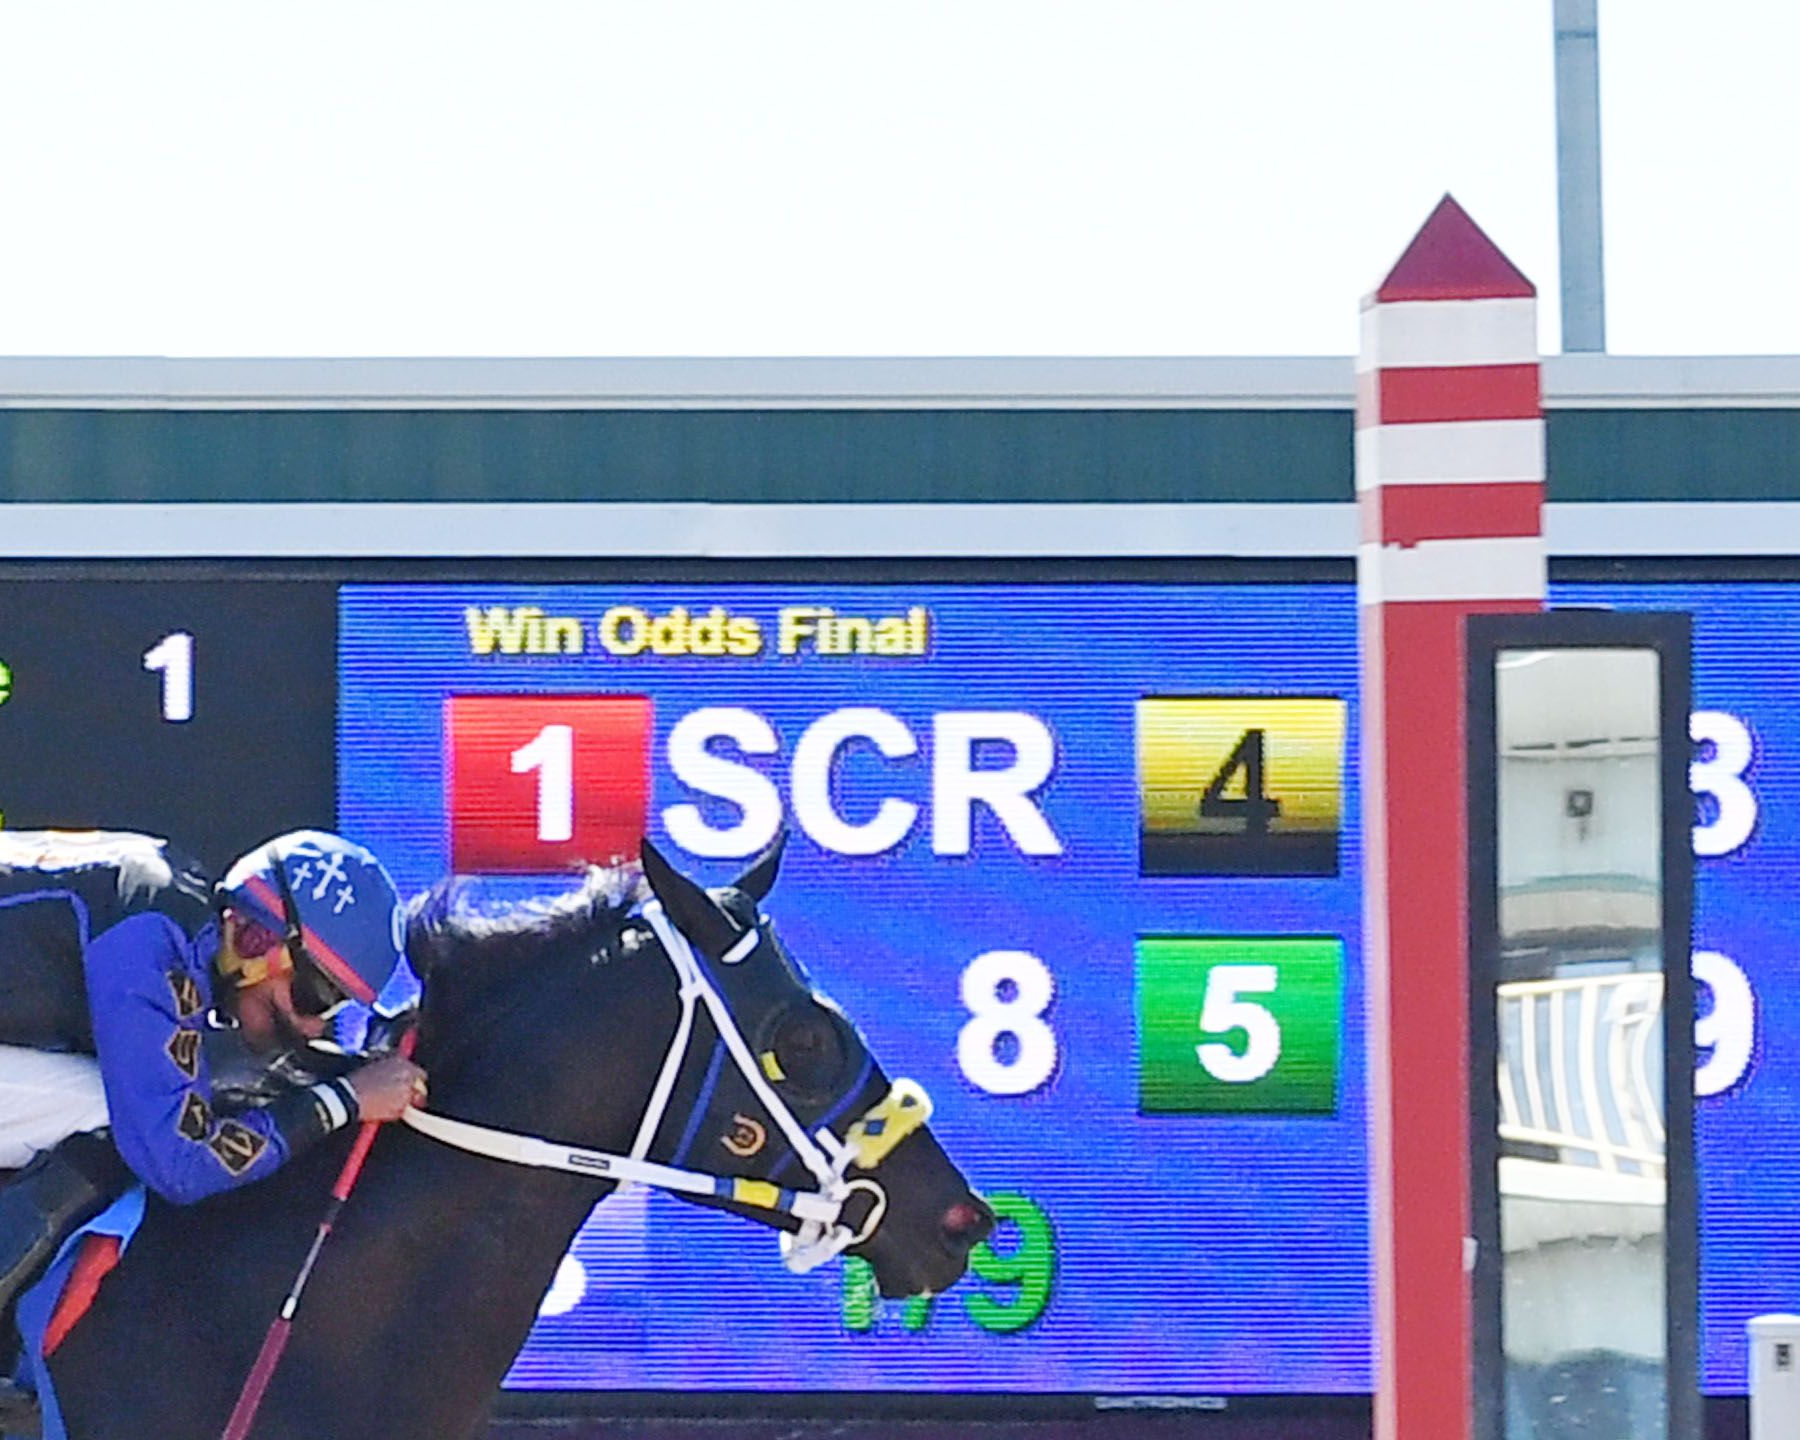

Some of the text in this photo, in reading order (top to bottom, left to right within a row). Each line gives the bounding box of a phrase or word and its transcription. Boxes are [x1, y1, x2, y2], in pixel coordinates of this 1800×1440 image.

[143, 632, 193, 722] 1
[464, 606, 930, 656] Win Odds Final
[511, 706, 1063, 858] 1 SCR
[1200, 728, 1281, 842] 4
[957, 950, 1057, 1095] 8
[1196, 964, 1282, 1082] 5
